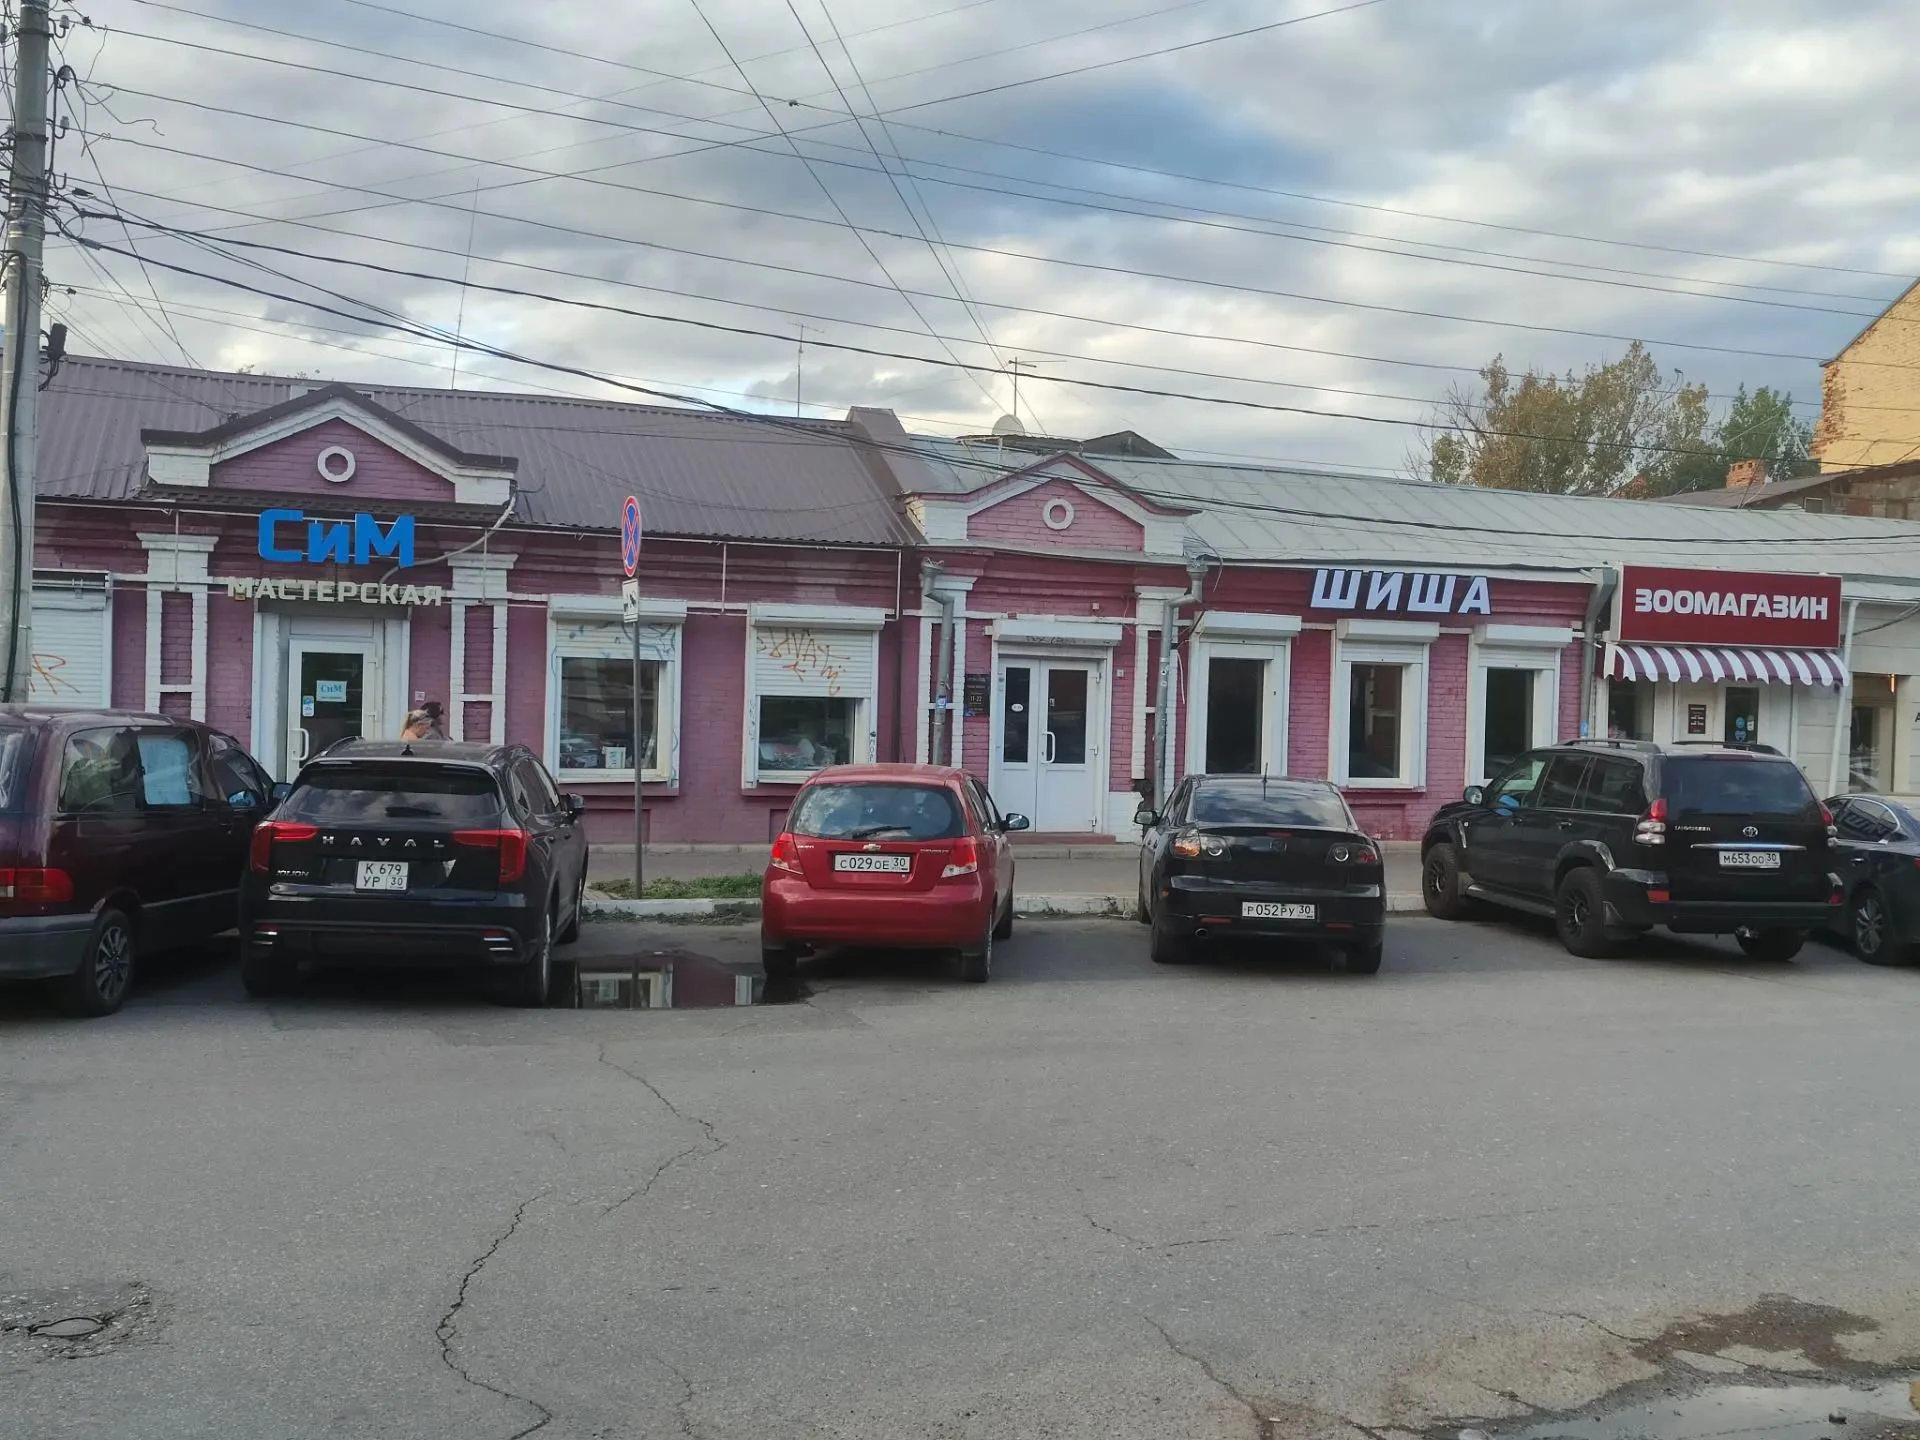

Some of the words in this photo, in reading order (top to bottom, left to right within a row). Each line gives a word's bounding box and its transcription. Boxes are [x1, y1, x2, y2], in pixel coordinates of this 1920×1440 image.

[258, 509, 415, 568] СиМ
[227, 576, 442, 607] МАСТЕРСКАЯ
[1309, 568, 1492, 615] ШИША
[1635, 588, 1828, 620] ЗООМАГАЗИН
[322, 835, 445, 848] HAVAL
